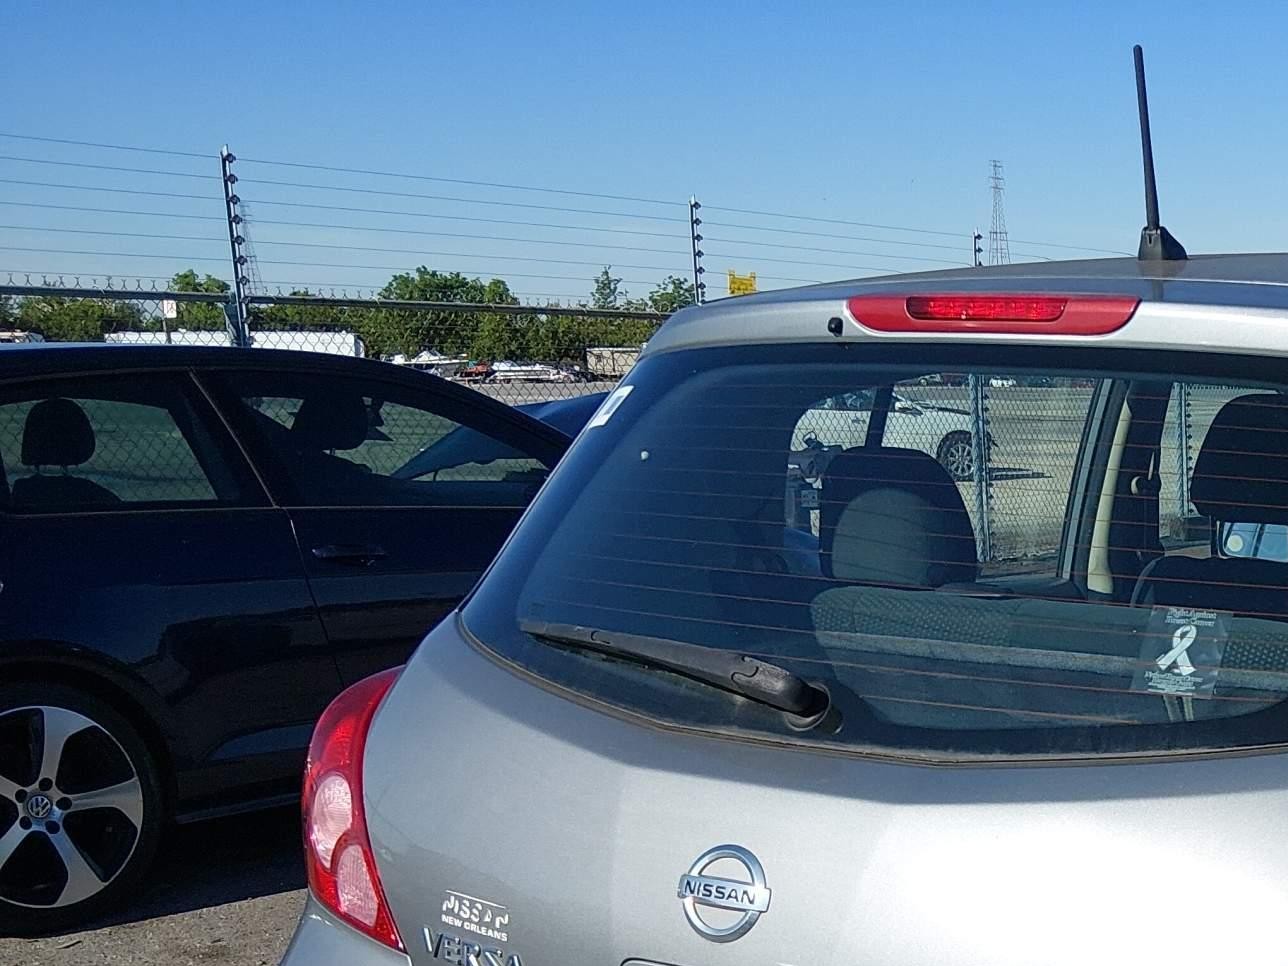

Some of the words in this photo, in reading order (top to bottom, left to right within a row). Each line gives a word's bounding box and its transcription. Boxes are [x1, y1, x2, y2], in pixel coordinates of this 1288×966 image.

[684, 879, 756, 905] NISSAN
[441, 914, 463, 927] NEW
[463, 921, 508, 942] ORLEANS
